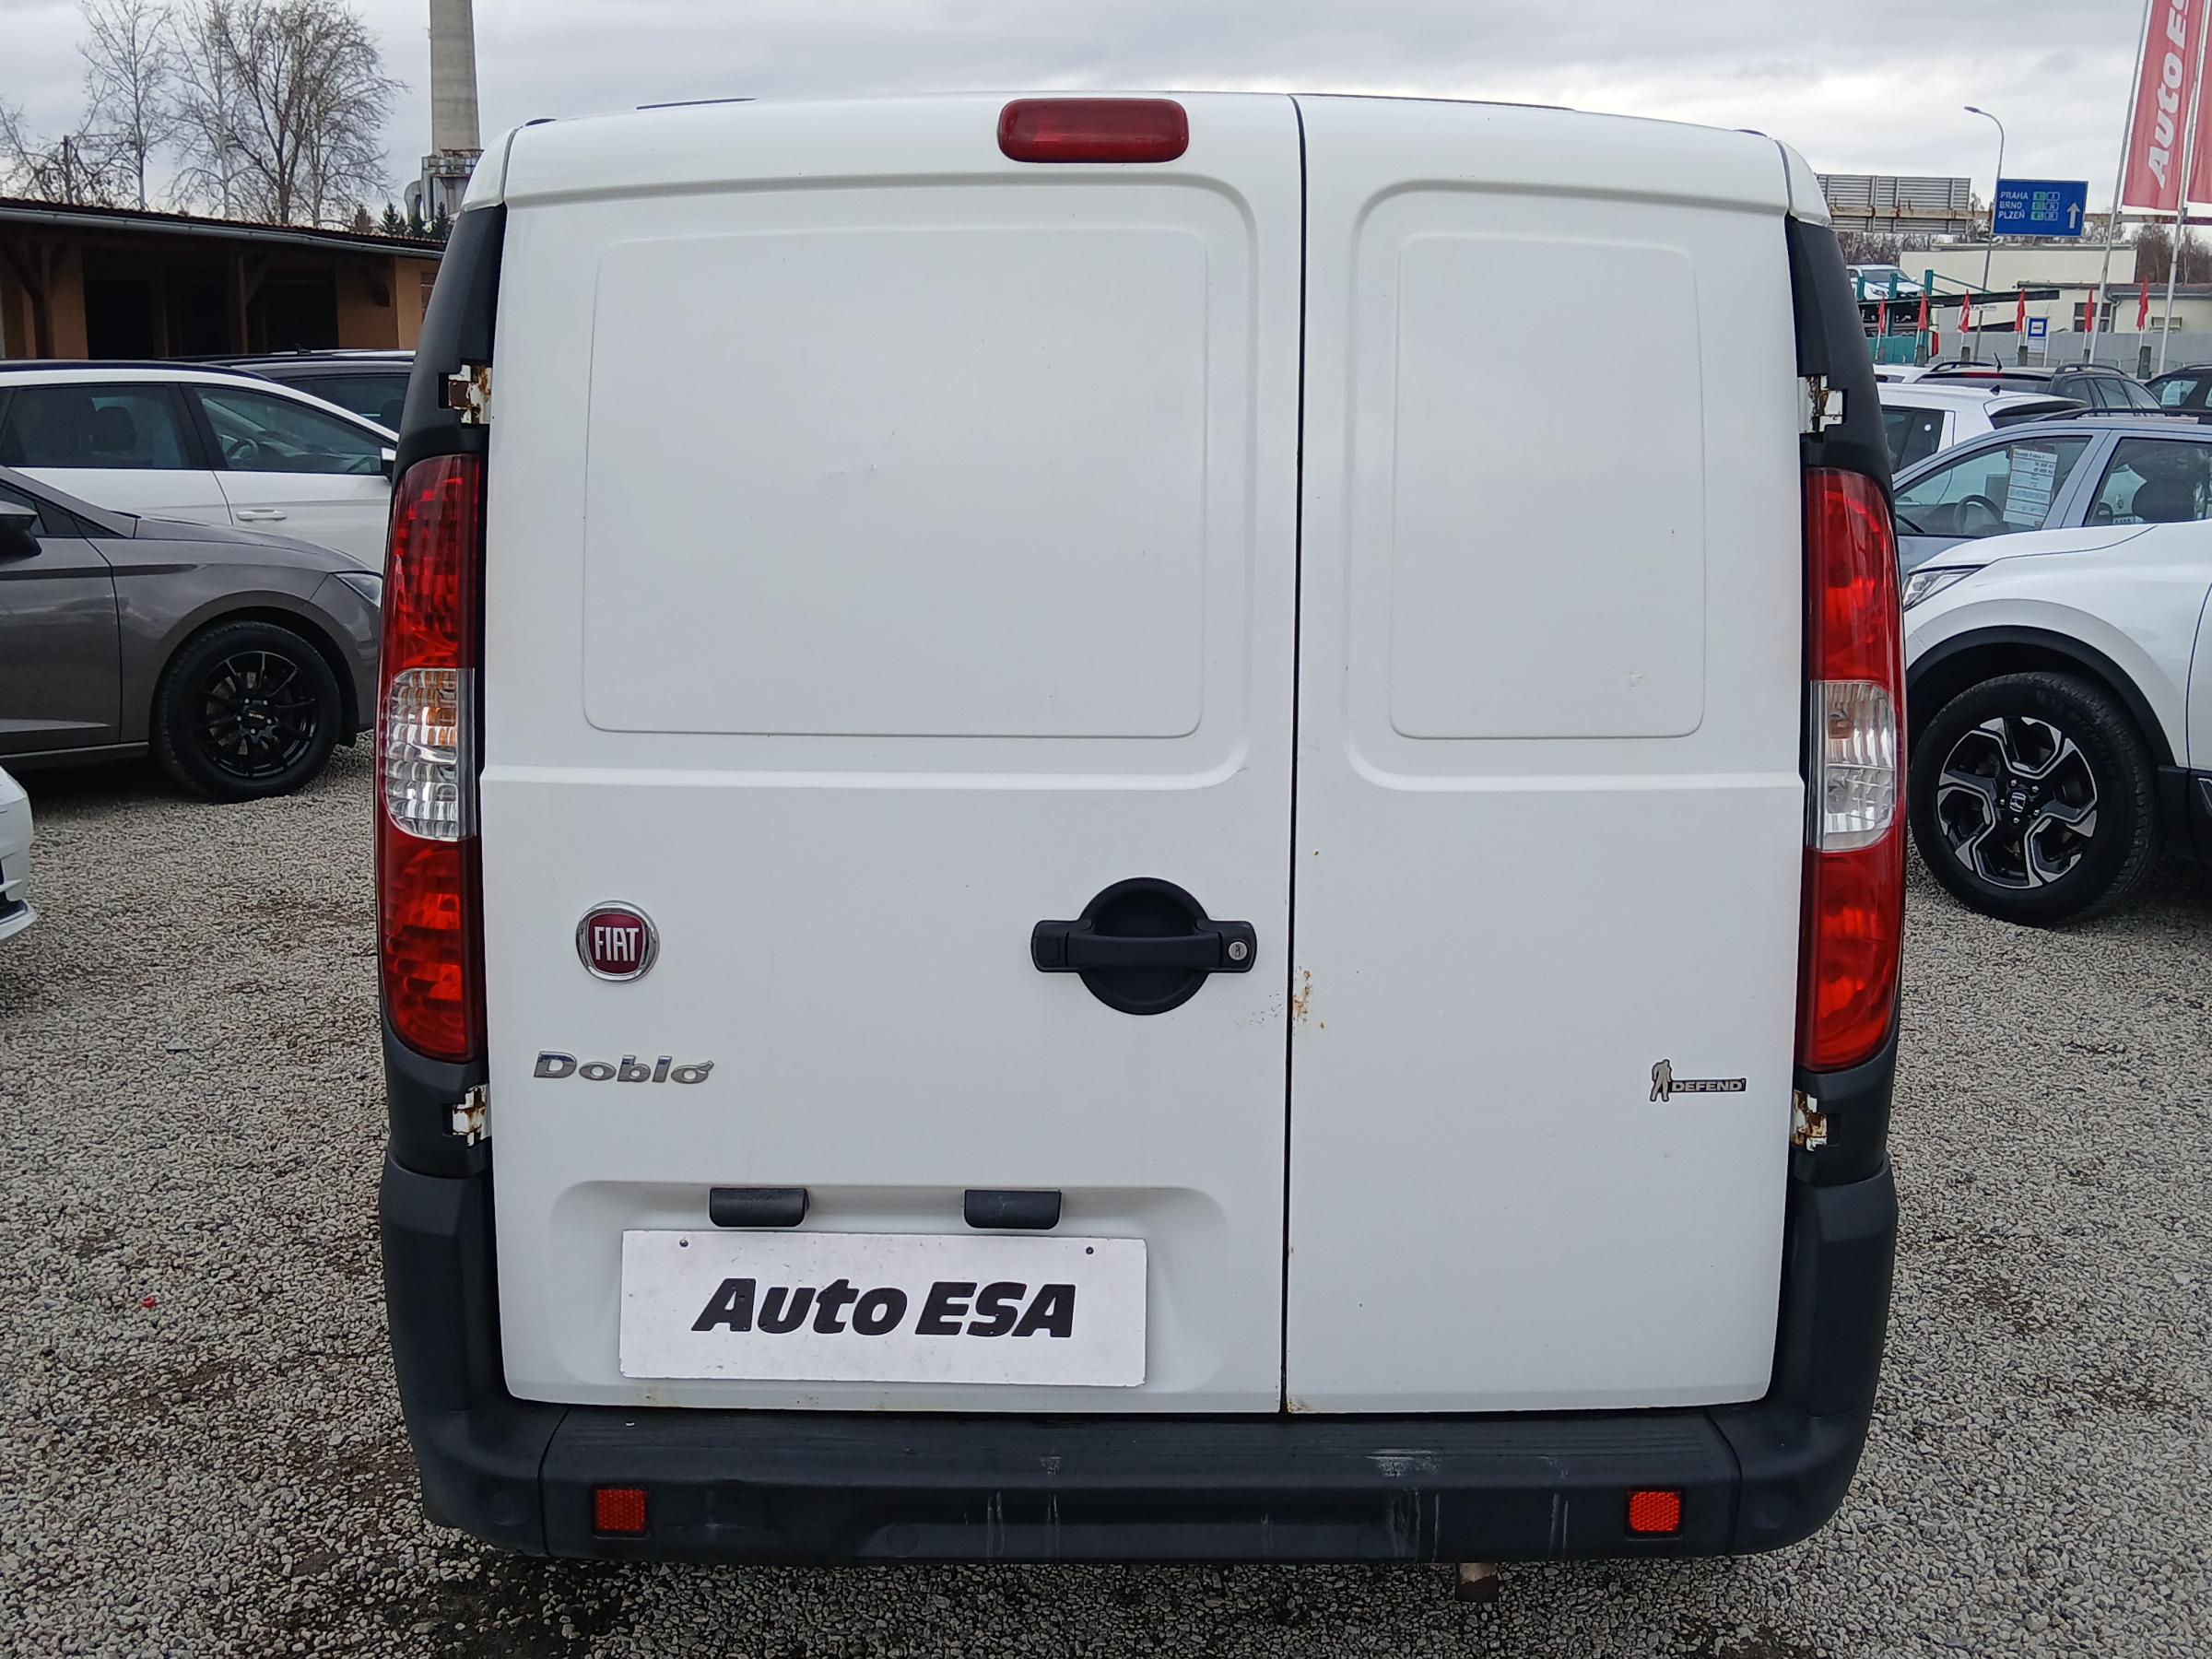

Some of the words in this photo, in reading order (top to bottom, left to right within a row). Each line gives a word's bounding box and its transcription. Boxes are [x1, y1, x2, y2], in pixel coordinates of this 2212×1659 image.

[2147, 52, 2183, 189] Auto
[1999, 200, 2023, 209] BRNO
[2000, 191, 2029, 200] PRAHA
[594, 925, 640, 962] FIAT
[1671, 1080, 1743, 1092] DEFEND
[690, 1277, 908, 1336] Auto
[914, 1281, 1076, 1338] ESA
